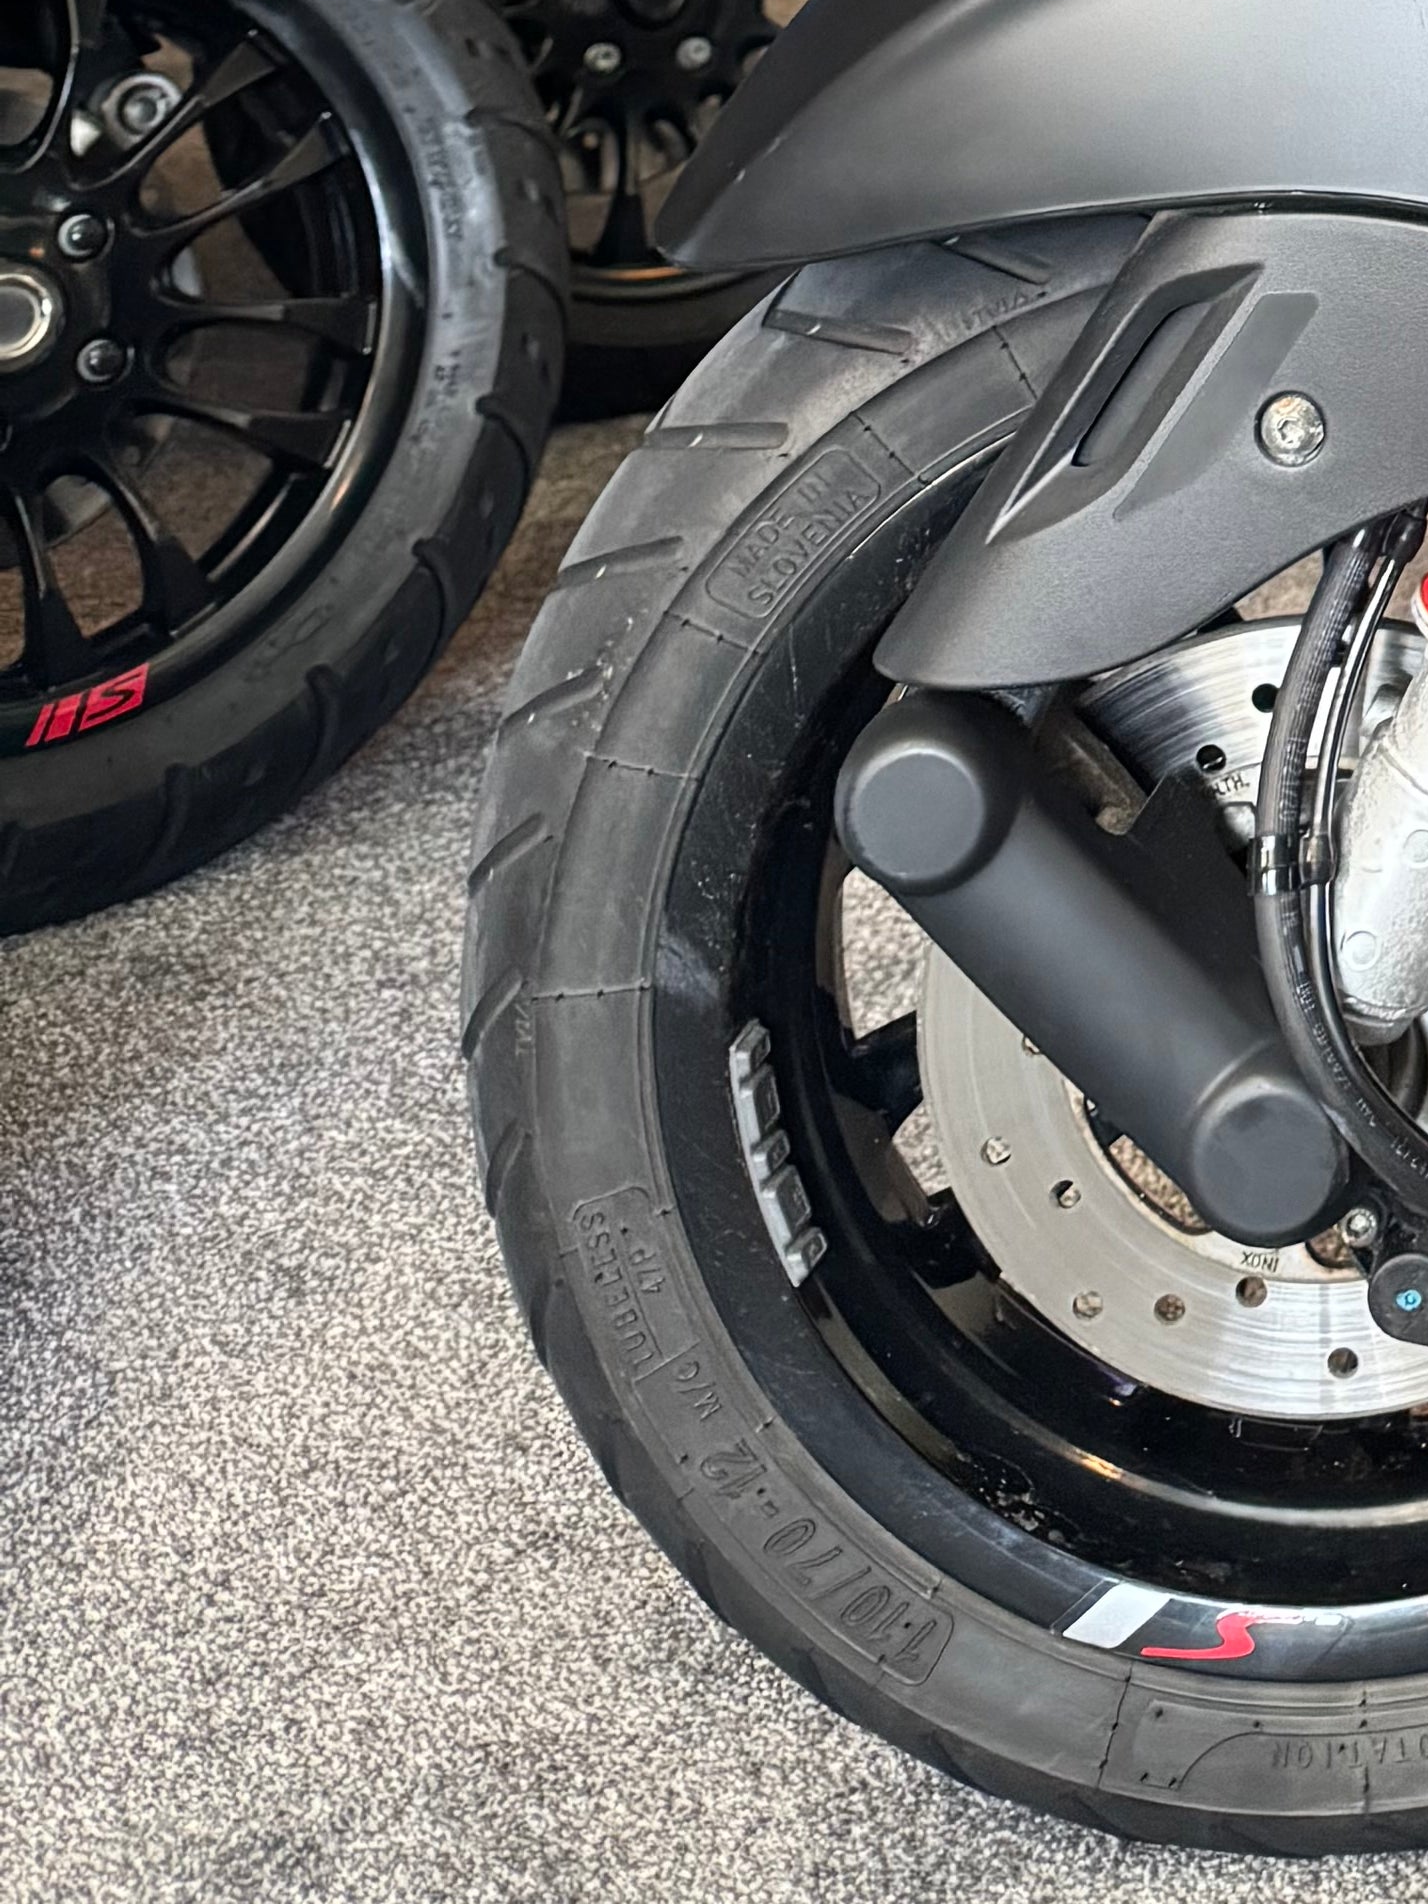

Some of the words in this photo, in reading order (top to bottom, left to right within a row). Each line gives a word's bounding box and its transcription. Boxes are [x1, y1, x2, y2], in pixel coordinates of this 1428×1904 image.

[727, 506, 796, 579] MADE
[747, 489, 873, 606] SLOVENIA
[578, 1211, 655, 1373] TUBELESS
[628, 1247, 667, 1295] 47P
[1240, 1250, 1280, 1274] INOX
[673, 1359, 722, 1422] M/C
